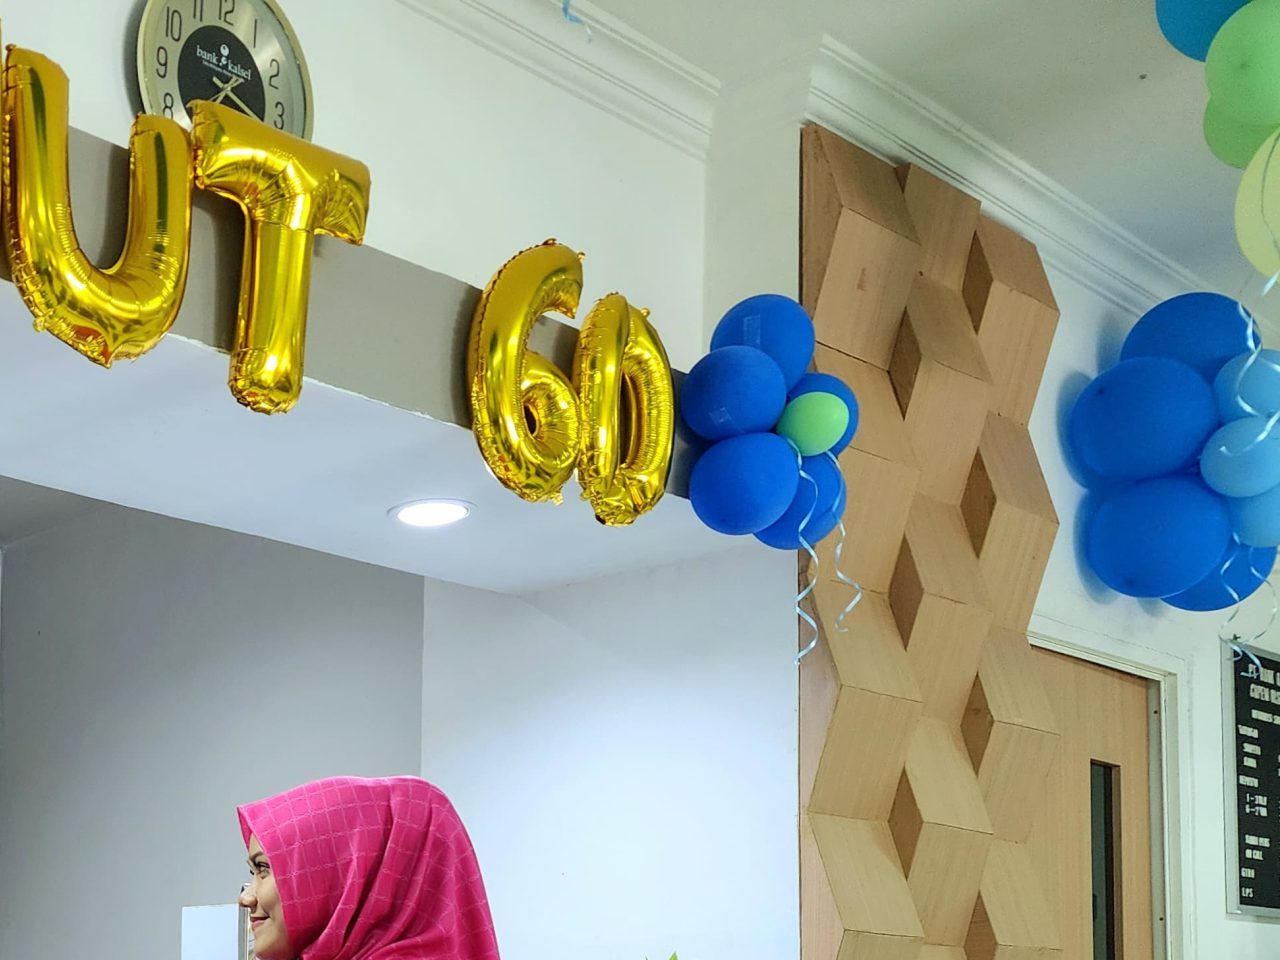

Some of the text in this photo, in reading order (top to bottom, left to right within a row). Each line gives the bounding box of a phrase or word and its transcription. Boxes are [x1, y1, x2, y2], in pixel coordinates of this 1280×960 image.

[165, 6, 183, 42] 10
[253, 18, 258, 49] 1
[156, 46, 168, 79] 9
[196, 45, 219, 65] bank
[228, 60, 252, 80] kalsel
[268, 59, 280, 90] 2
[273, 101, 285, 130] 3
[467, 238, 674, 526] 60
[1241, 887, 1254, 898] LPS
